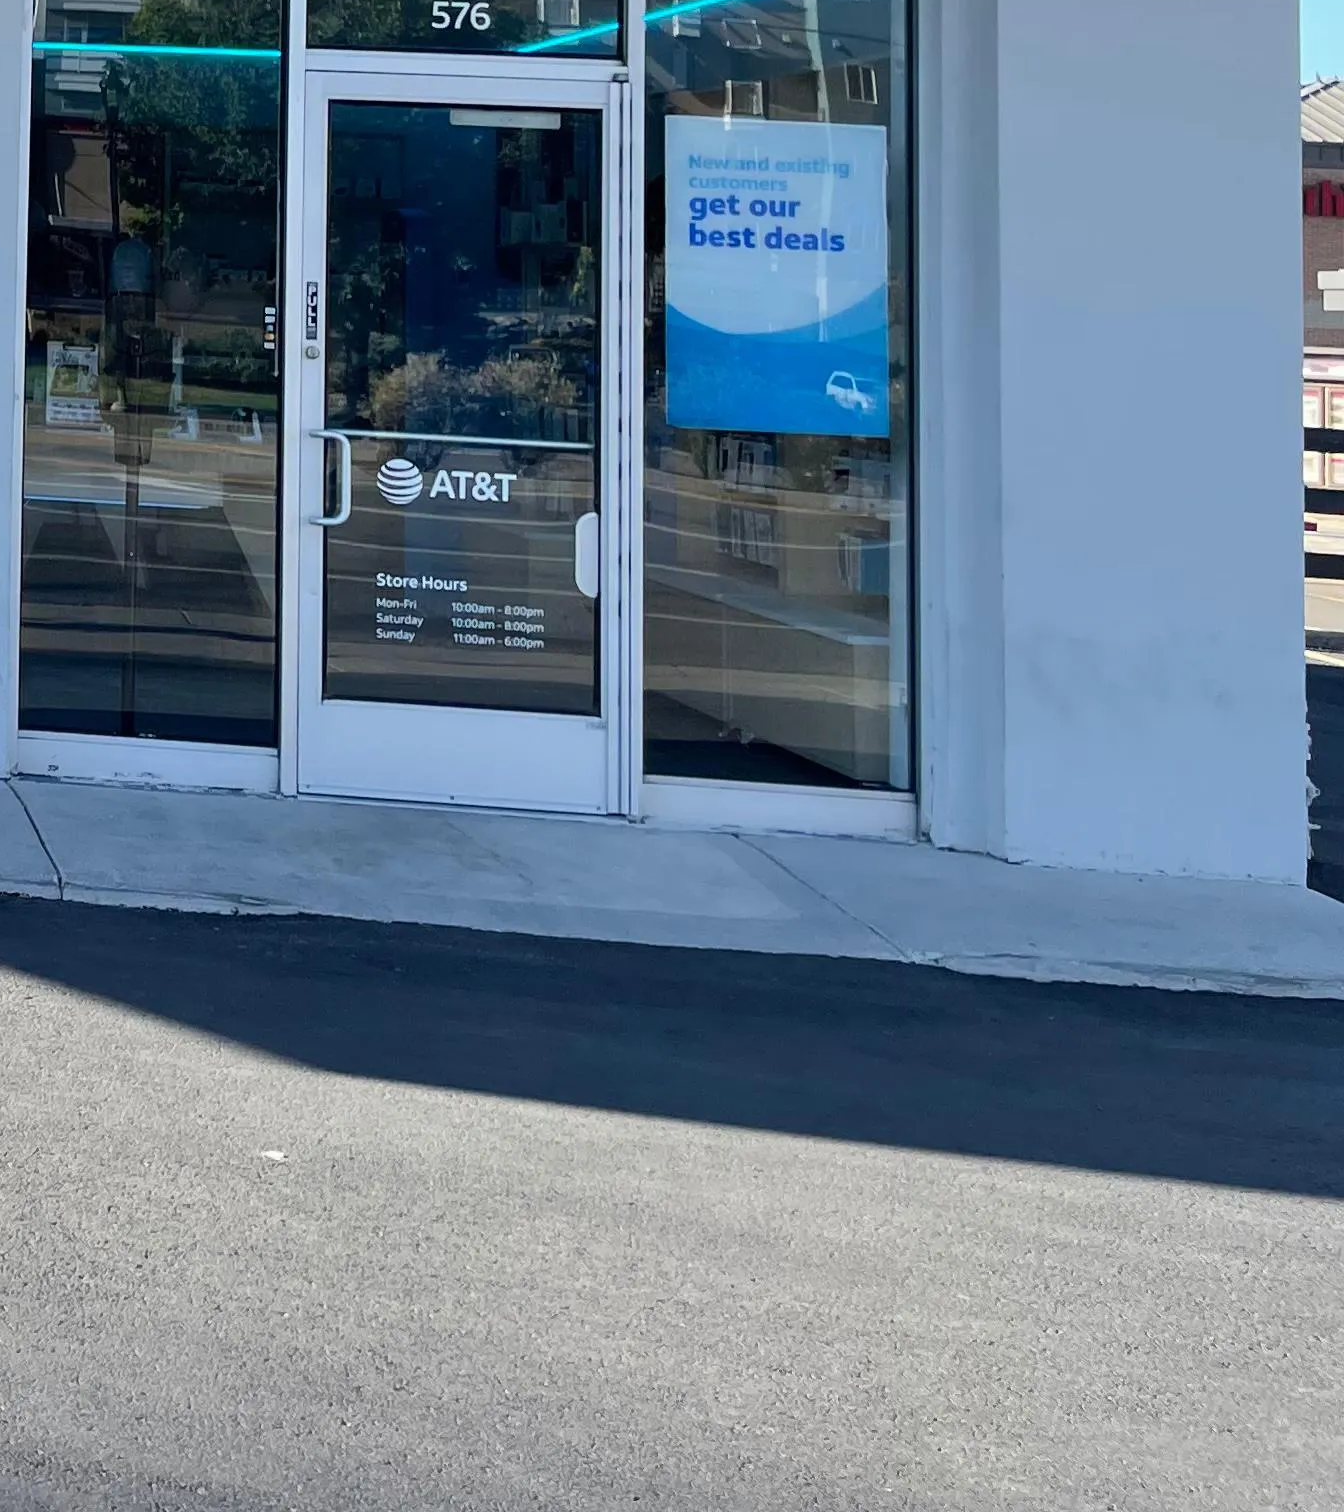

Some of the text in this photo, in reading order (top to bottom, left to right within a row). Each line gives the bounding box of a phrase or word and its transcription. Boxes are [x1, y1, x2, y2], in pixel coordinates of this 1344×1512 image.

[431, 0, 491, 31] 576
[688, 154, 850, 179] New and existing
[688, 175, 788, 192] customers
[689, 194, 801, 221] get our
[689, 222, 845, 252] best deals
[307, 285, 317, 327] PULL
[429, 469, 518, 502] AT&T
[376, 572, 468, 592] Store Hours
[376, 597, 417, 610] Mon-Fri
[451, 601, 495, 615] 10:00am
[504, 605, 545, 620] 8:00pm
[376, 613, 424, 629] Saturday
[451, 617, 495, 631] 10:00am
[504, 620, 545, 635] 8:00pm
[376, 628, 416, 643] Sunday
[453, 632, 495, 646] 11:00am
[504, 636, 545, 650] 6:00pm
